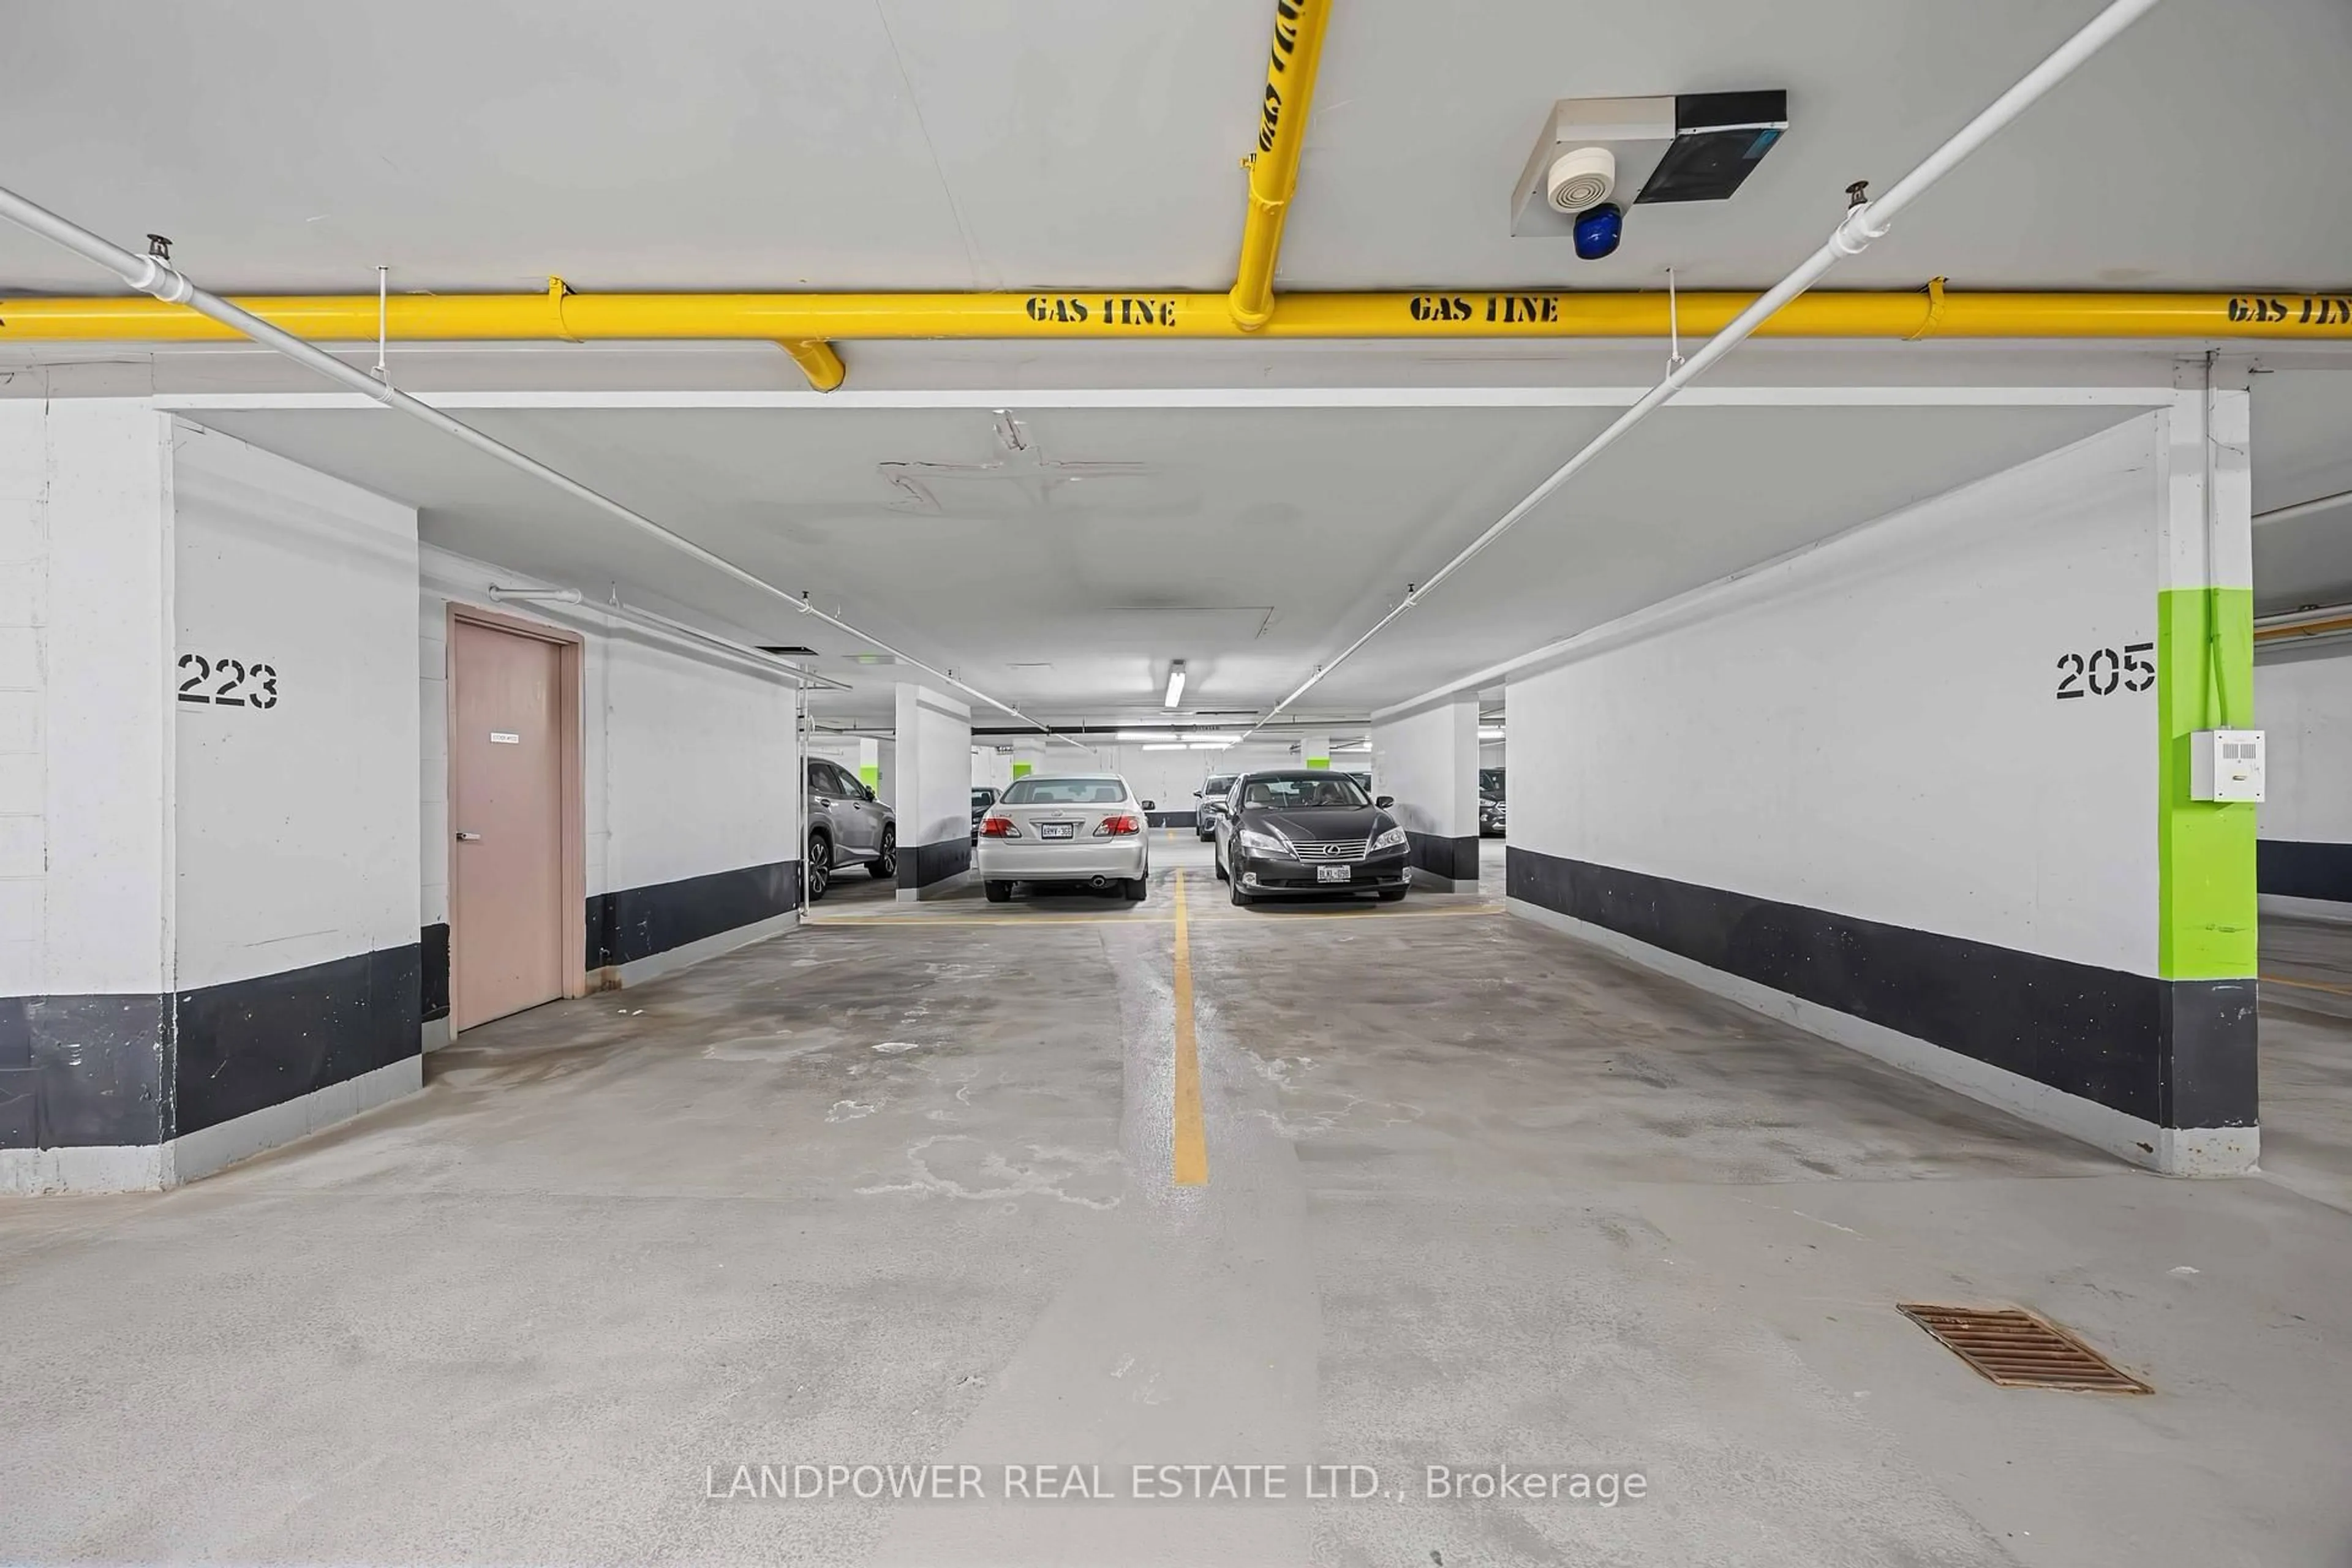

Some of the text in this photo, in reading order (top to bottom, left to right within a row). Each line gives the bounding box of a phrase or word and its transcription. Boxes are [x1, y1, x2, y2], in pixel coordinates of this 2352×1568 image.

[1026, 297, 1176, 327] GAS LINE
[1410, 296, 1559, 323] GAS LINE
[2228, 298, 2352, 325] GAS LIN
[178, 654, 277, 709] 223
[2056, 642, 2156, 699] 205
